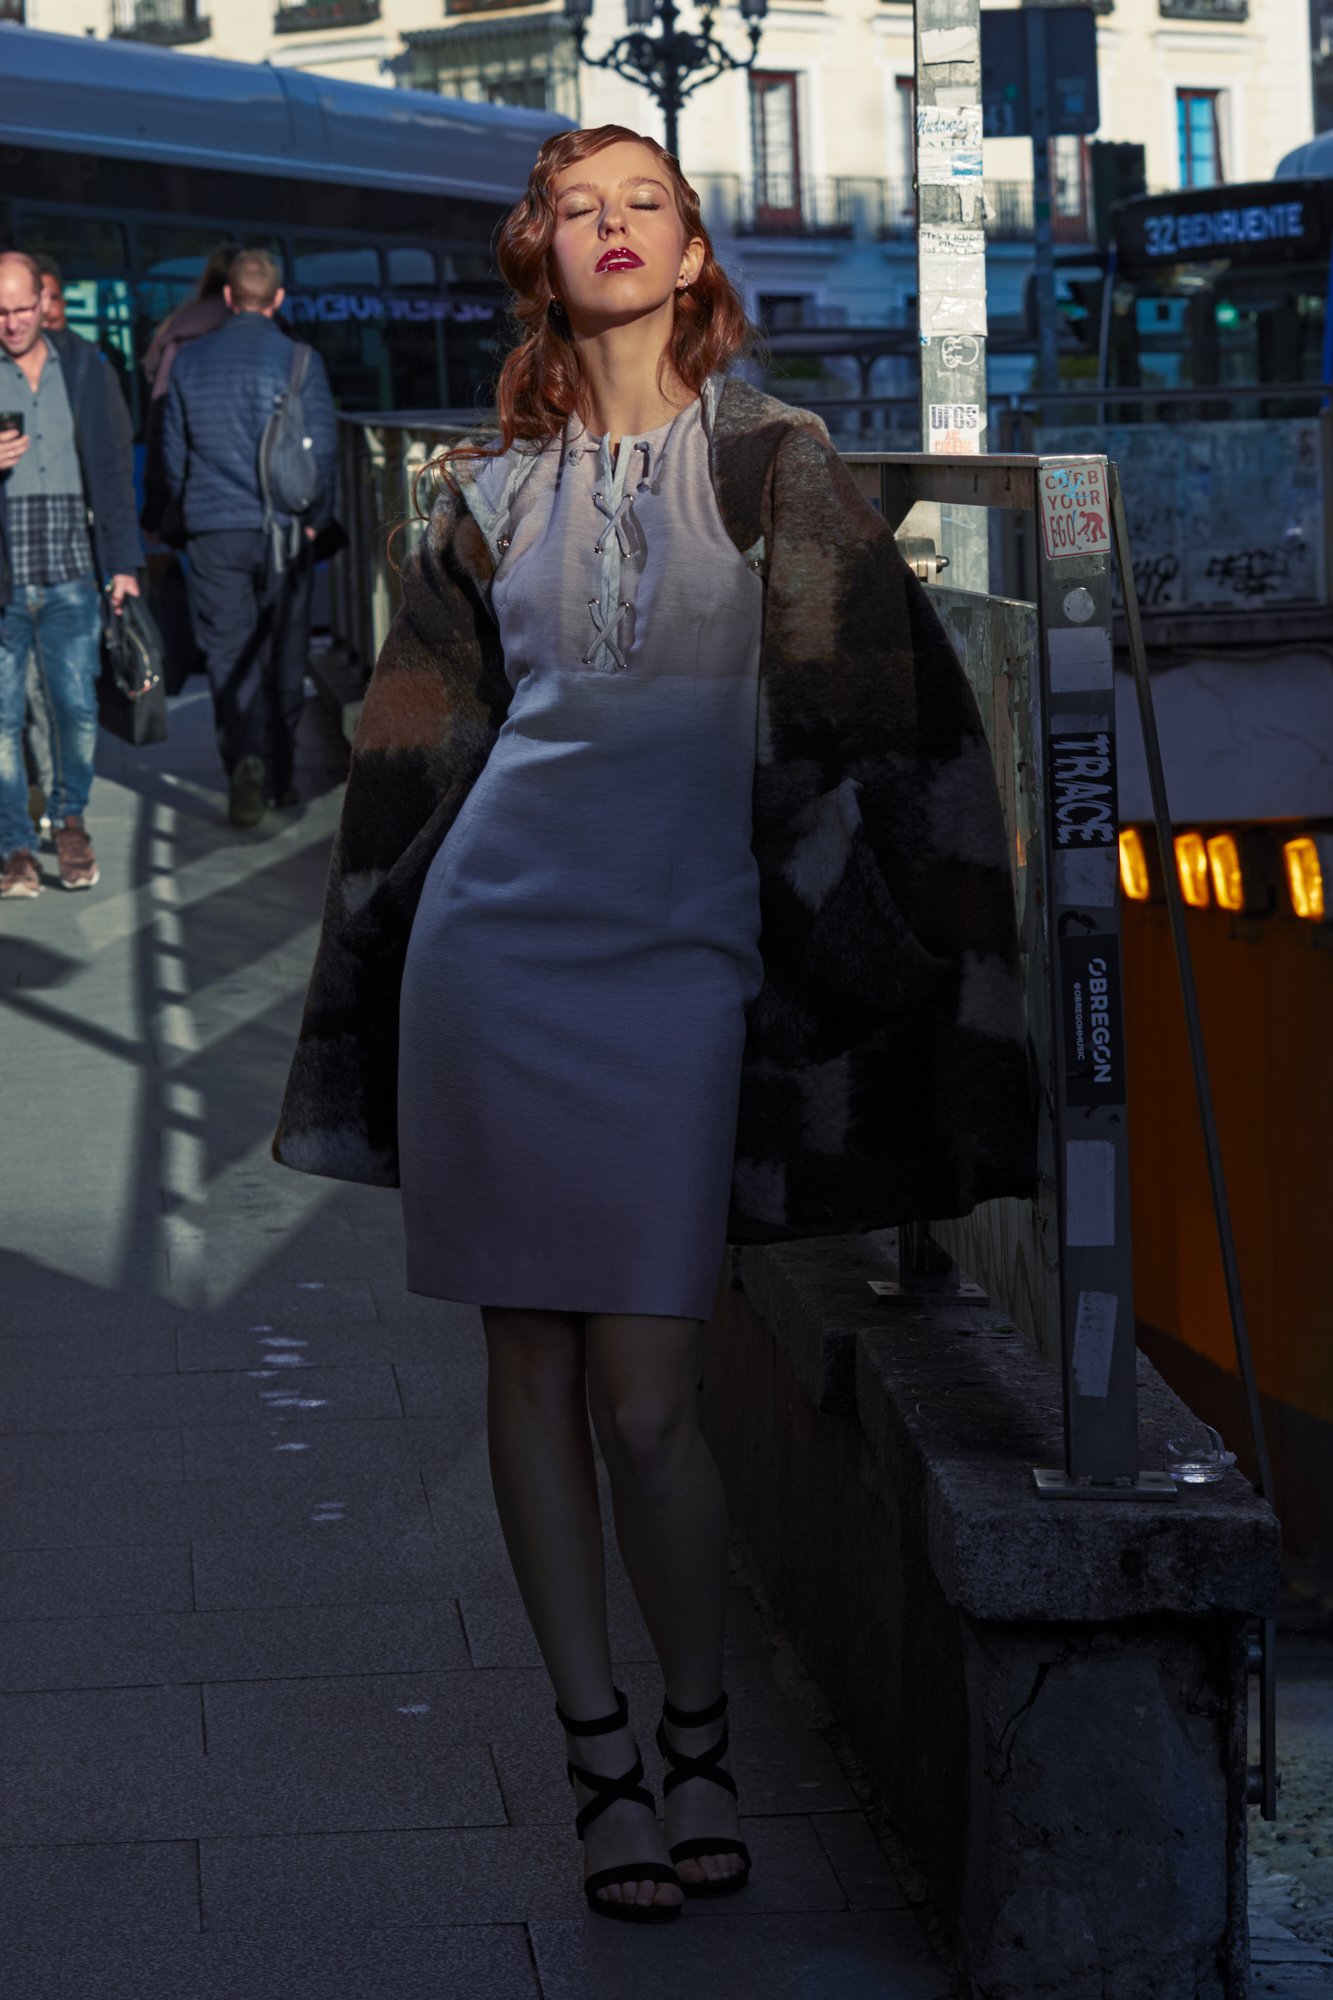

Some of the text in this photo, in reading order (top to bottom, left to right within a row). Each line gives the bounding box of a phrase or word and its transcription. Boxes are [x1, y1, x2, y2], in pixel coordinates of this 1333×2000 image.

[1144, 202, 1304, 256] 32 BENAVENTE
[1047, 490, 1100, 510] YOUR
[1050, 514, 1076, 548] EGO
[1053, 734, 1114, 843] TRACE
[1074, 982, 1086, 1060] @OBREGONMUSIC
[1088, 957, 1112, 1083] OBREGON
